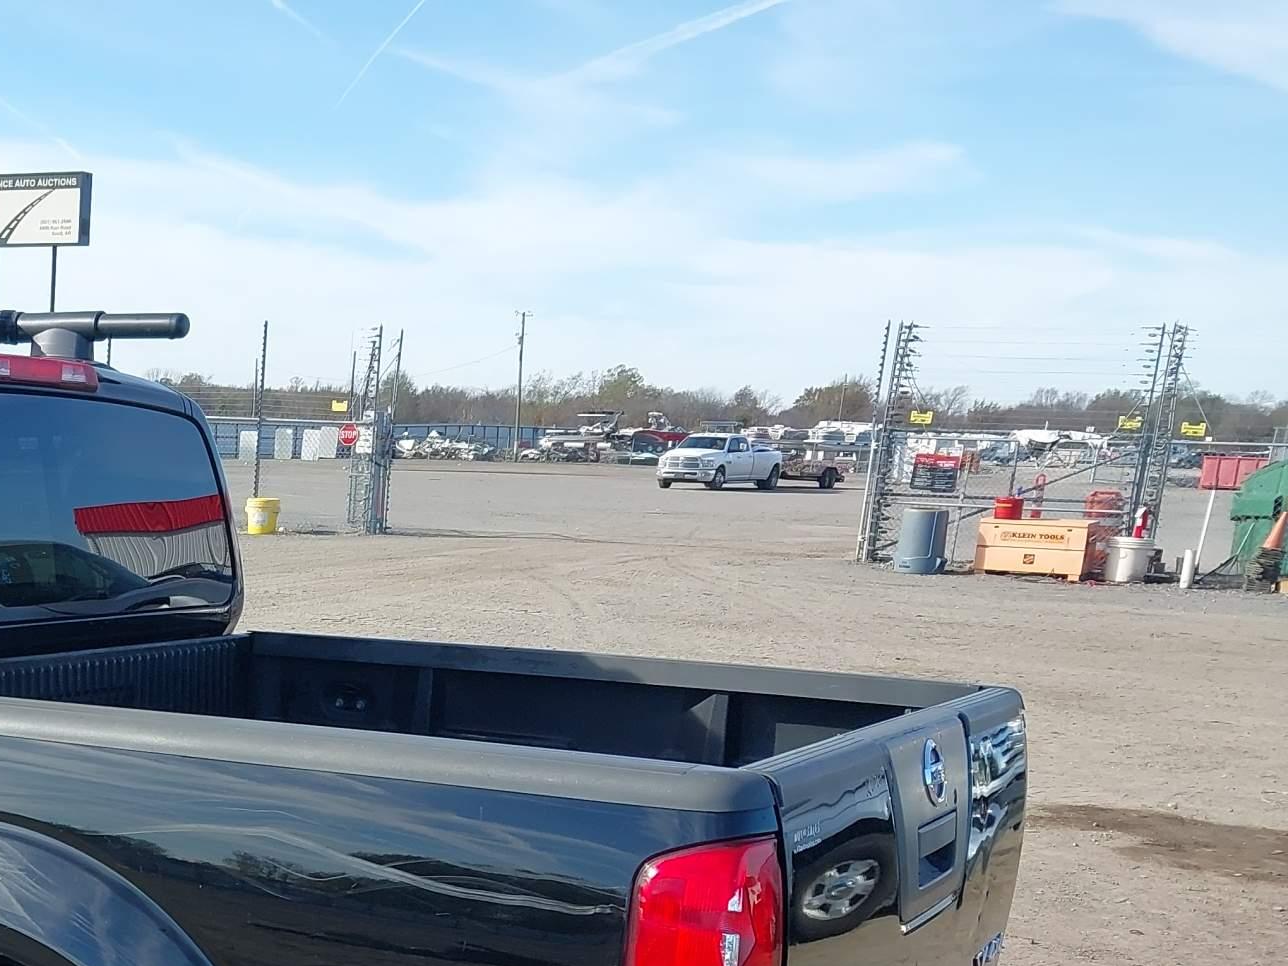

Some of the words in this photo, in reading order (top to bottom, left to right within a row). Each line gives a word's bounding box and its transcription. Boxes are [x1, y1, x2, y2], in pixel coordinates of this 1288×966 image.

[14, 179, 35, 188] AUTO
[37, 177, 77, 187] AUCTIONS
[340, 430, 357, 439] STOP
[1011, 531, 1037, 539] KLEIN
[1039, 533, 1065, 541] TOOLS
